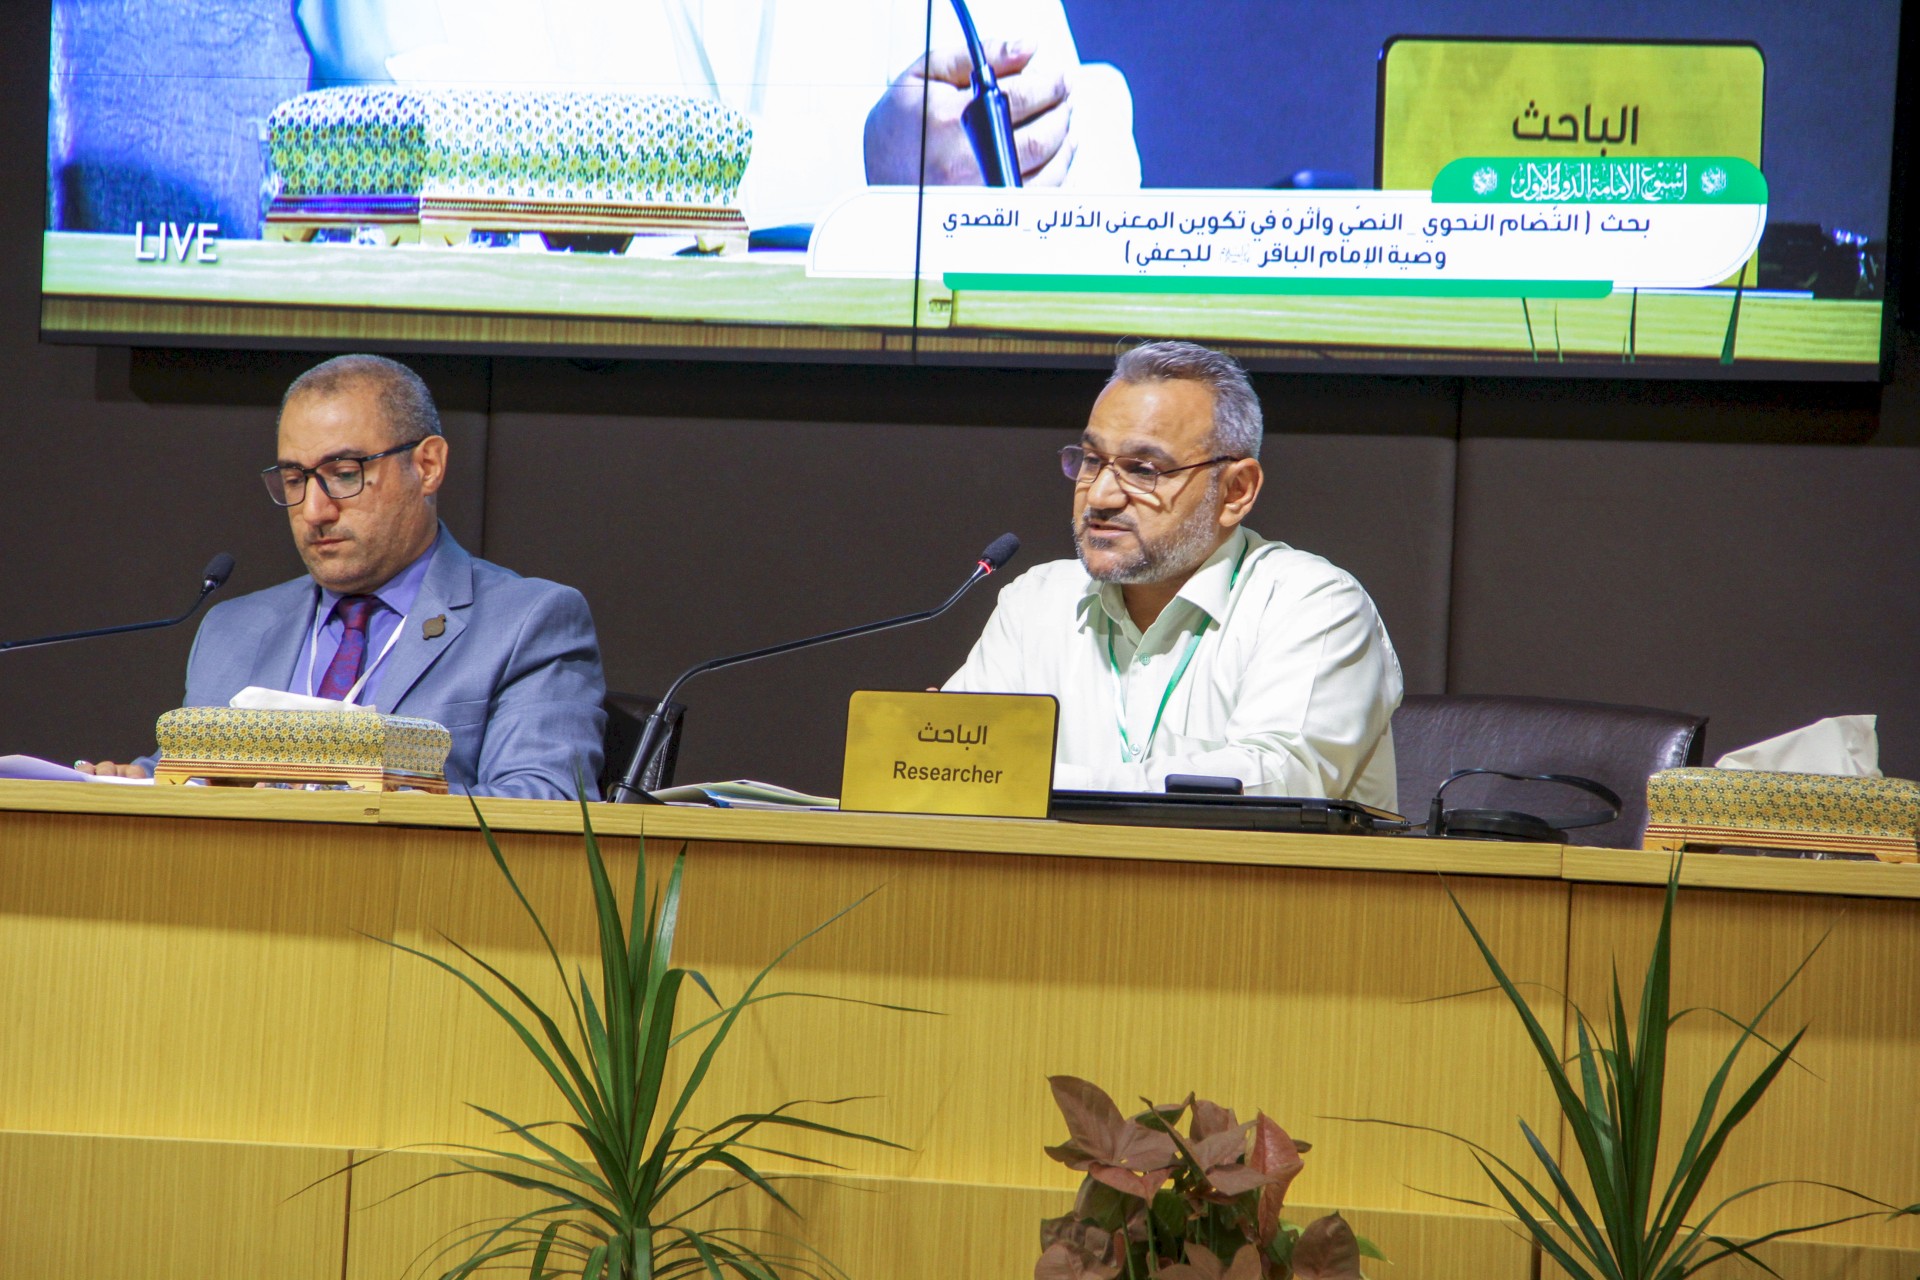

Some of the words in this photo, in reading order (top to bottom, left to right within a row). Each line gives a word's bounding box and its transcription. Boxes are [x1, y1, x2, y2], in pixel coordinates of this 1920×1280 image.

[1513, 101, 1639, 156] الباحث
[943, 208, 1019, 238] القصدي
[1106, 211, 1174, 233] المعنى
[1179, 211, 1245, 235] تكوين
[1251, 210, 1276, 242] في
[1422, 214, 1494, 243] النحوي
[1601, 214, 1650, 238] بحث
[135, 221, 218, 262] LIVE
[1258, 240, 1314, 269] الباقر
[1136, 243, 1211, 273] للجعفي
[1388, 246, 1446, 270] وصية
[918, 722, 987, 750] الباحث
[893, 761, 1003, 783] Researcher
